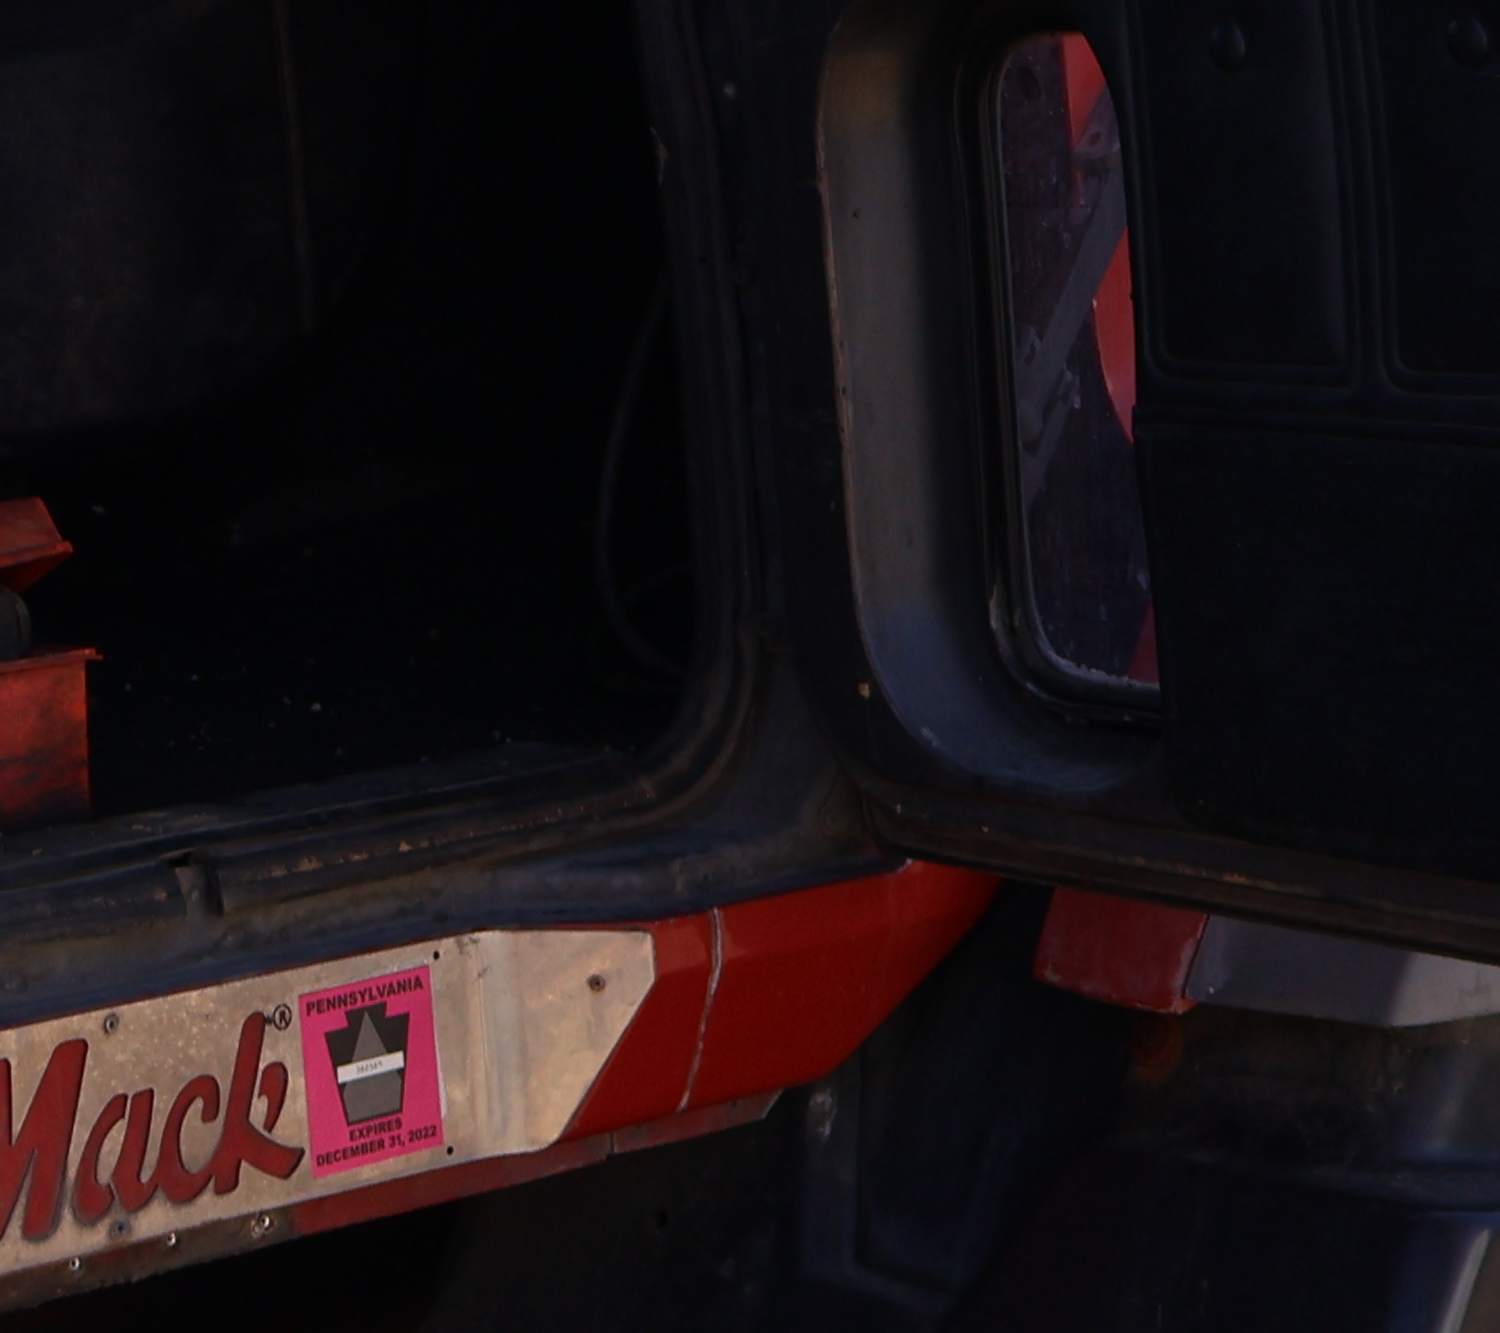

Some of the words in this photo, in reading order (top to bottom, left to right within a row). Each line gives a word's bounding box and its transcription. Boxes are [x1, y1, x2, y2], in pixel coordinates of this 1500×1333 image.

[306, 975, 424, 1017] PENNSYLVANIA
[316, 1136, 386, 1167] DECEMBER
[388, 1133, 406, 1149] 31,
[408, 1124, 437, 1143] 2022
[349, 1117, 403, 1142] EXPIRES
